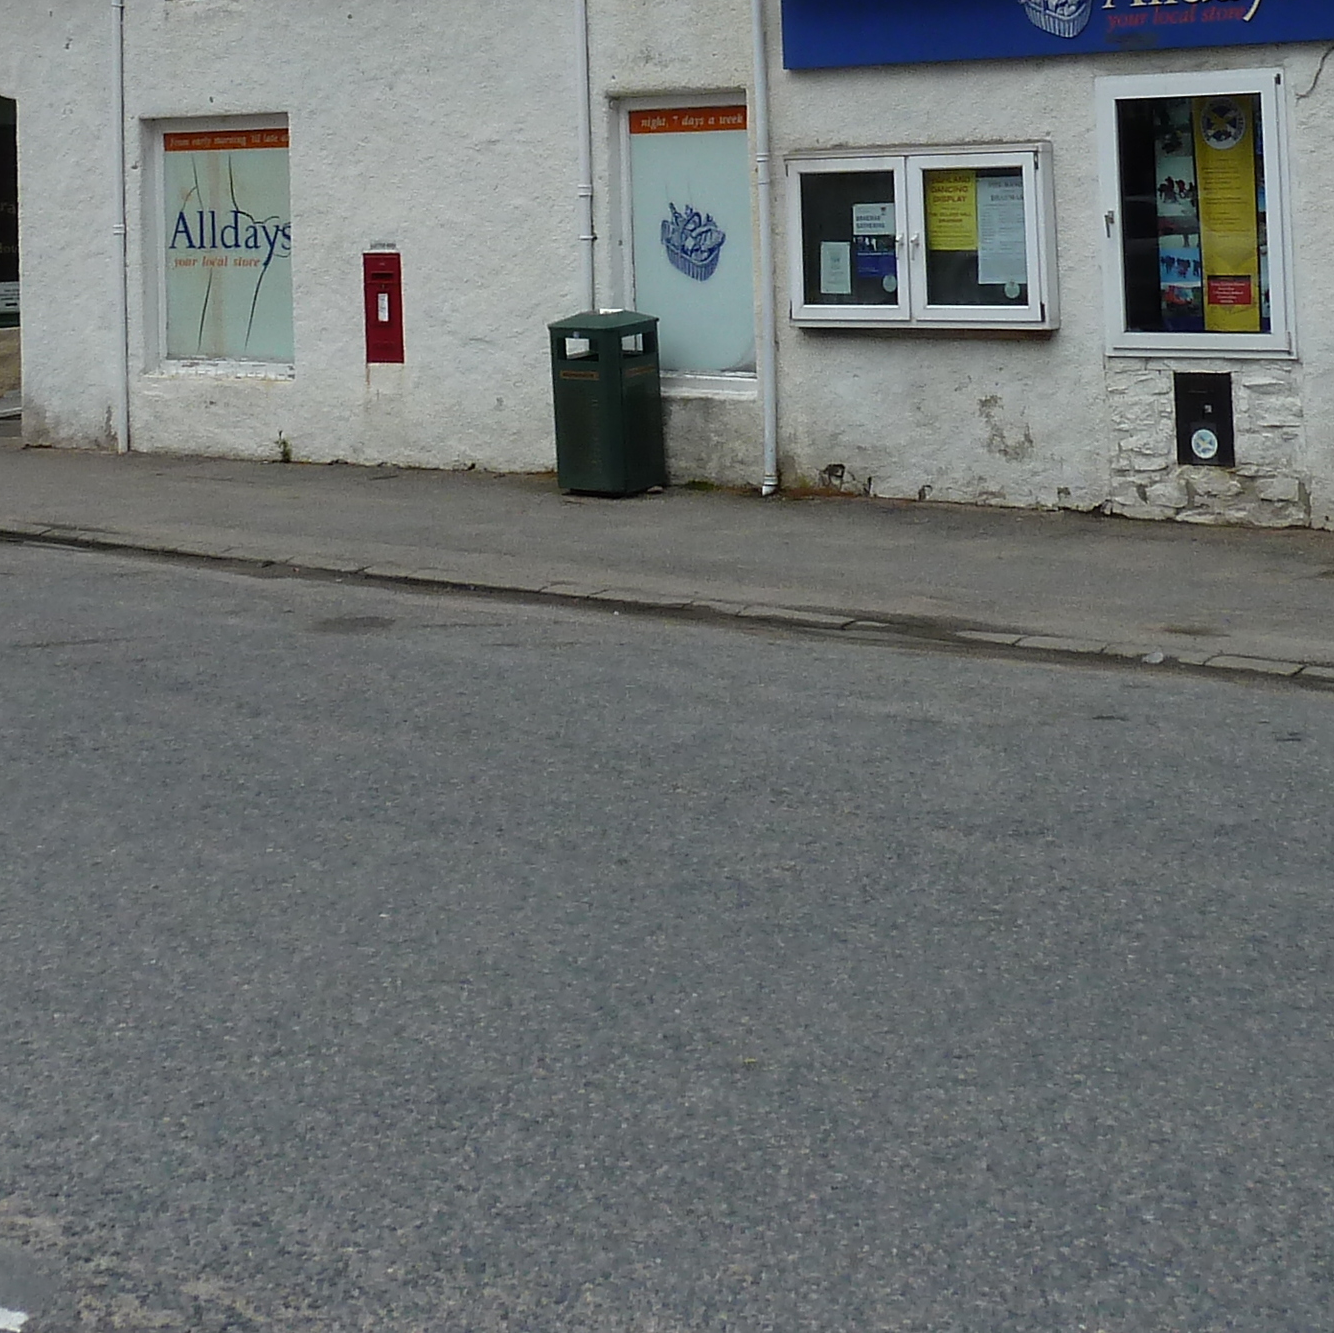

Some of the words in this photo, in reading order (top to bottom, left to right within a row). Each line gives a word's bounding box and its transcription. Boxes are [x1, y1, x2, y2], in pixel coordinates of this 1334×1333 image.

[1107, 11, 1148, 34] your
[1152, 3, 1197, 25] local
[1201, 6, 1247, 23] store
[681, 115, 705, 129] days
[708, 116, 715, 126] a
[719, 113, 743, 125] week
[932, 195, 967, 203] DISPLAY
[169, 210, 291, 266] Alldays
[174, 258, 198, 268] your
[202, 255, 228, 267] local
[233, 257, 260, 267] store
